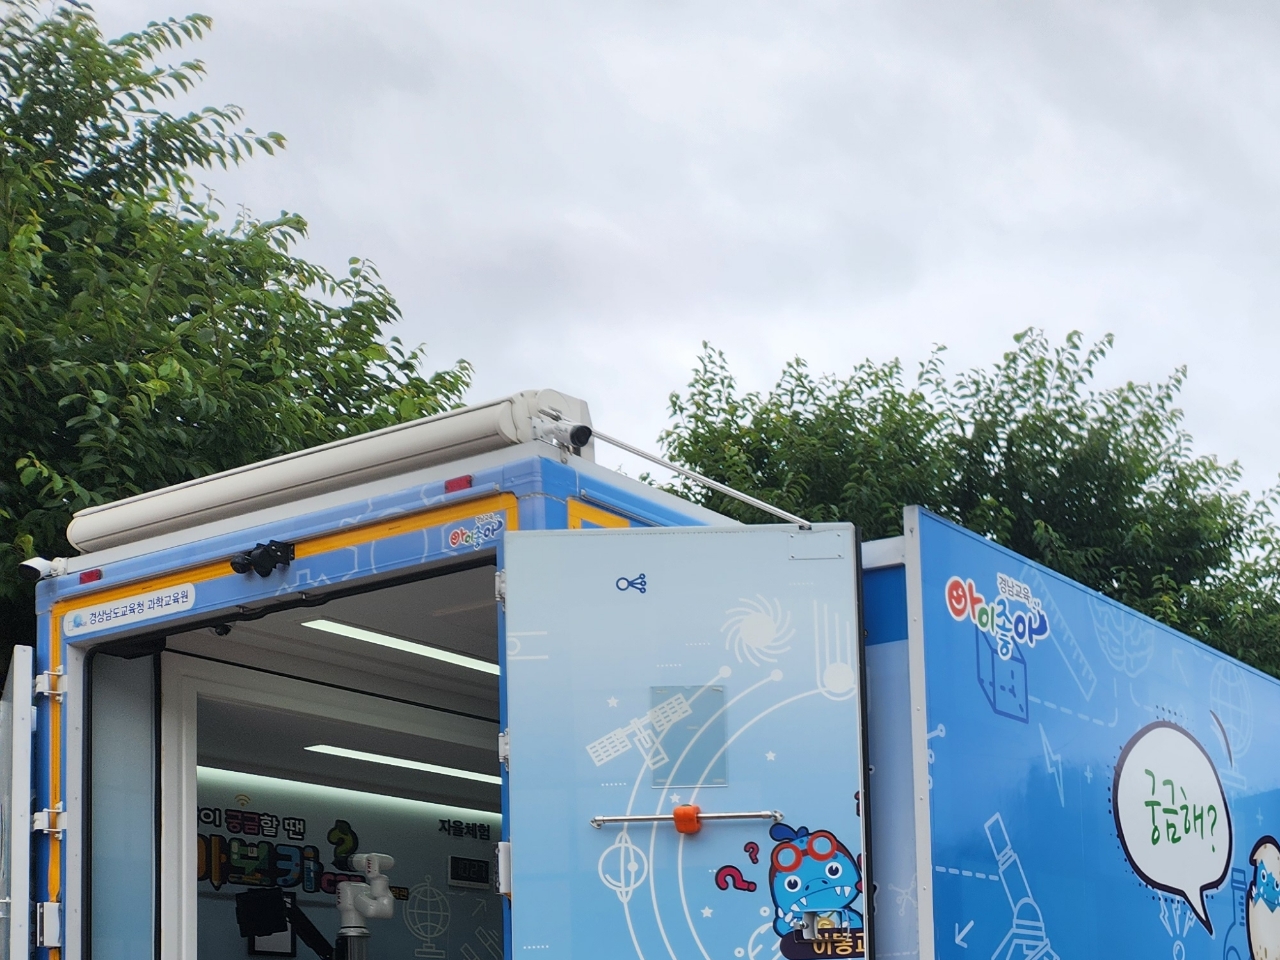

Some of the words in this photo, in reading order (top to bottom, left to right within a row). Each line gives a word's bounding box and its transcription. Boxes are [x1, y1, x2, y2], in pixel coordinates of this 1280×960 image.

[999, 576, 1030, 605] 경남교육
[89, 601, 144, 625] 경상남도교육청
[147, 590, 189, 610] 과학교육원
[947, 579, 1049, 657] 아이좋아
[225, 809, 279, 837] 궁금할
[283, 818, 305, 840] 땐
[1144, 768, 1217, 854] 궁금해?
[438, 818, 490, 840] 자율체험
